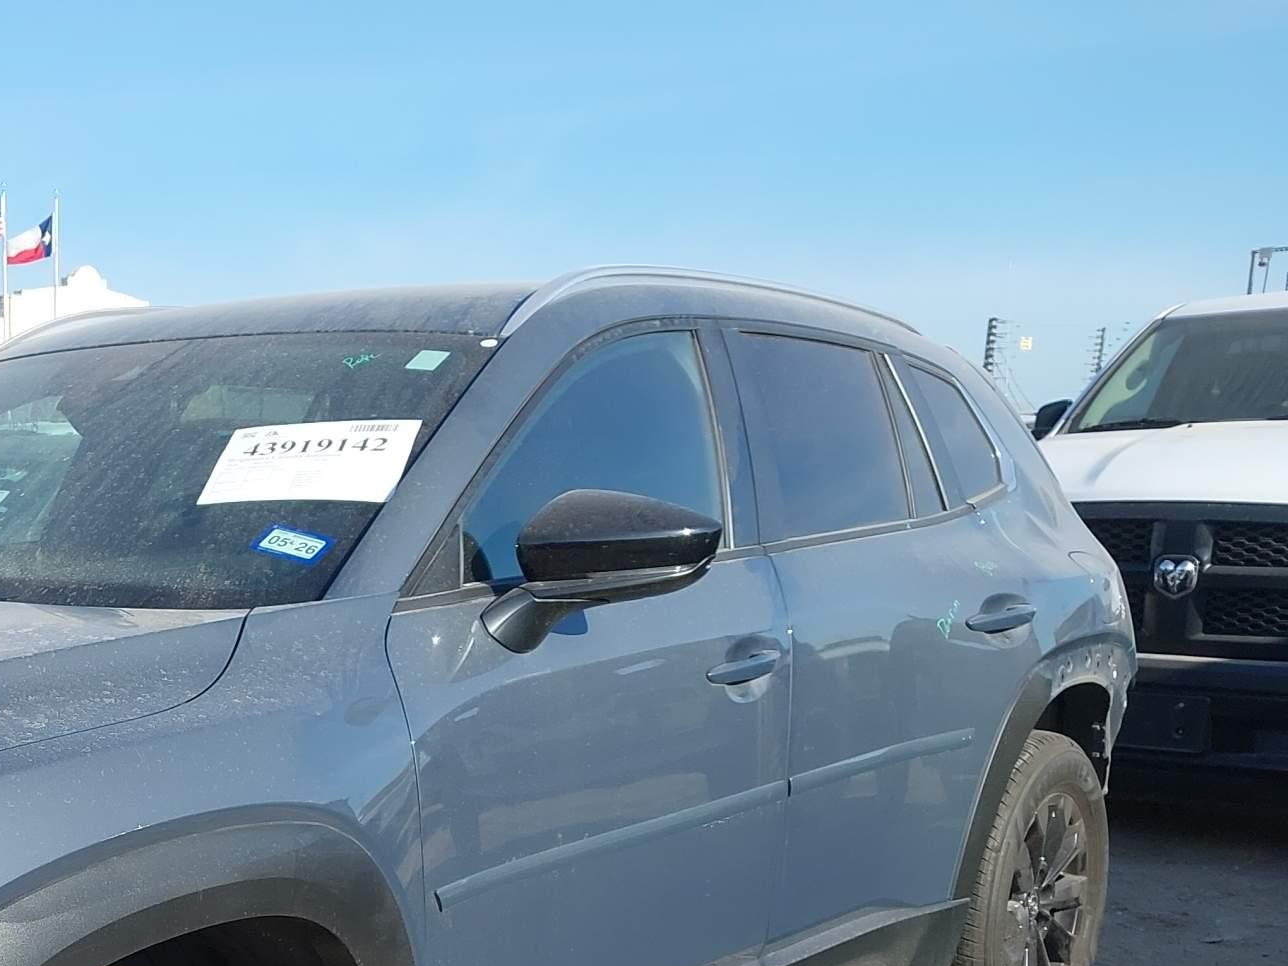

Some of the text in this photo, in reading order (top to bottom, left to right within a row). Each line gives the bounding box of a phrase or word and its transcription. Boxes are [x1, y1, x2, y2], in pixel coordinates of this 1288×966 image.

[243, 437, 388, 457] 43919142
[268, 535, 318, 554] 05 26
